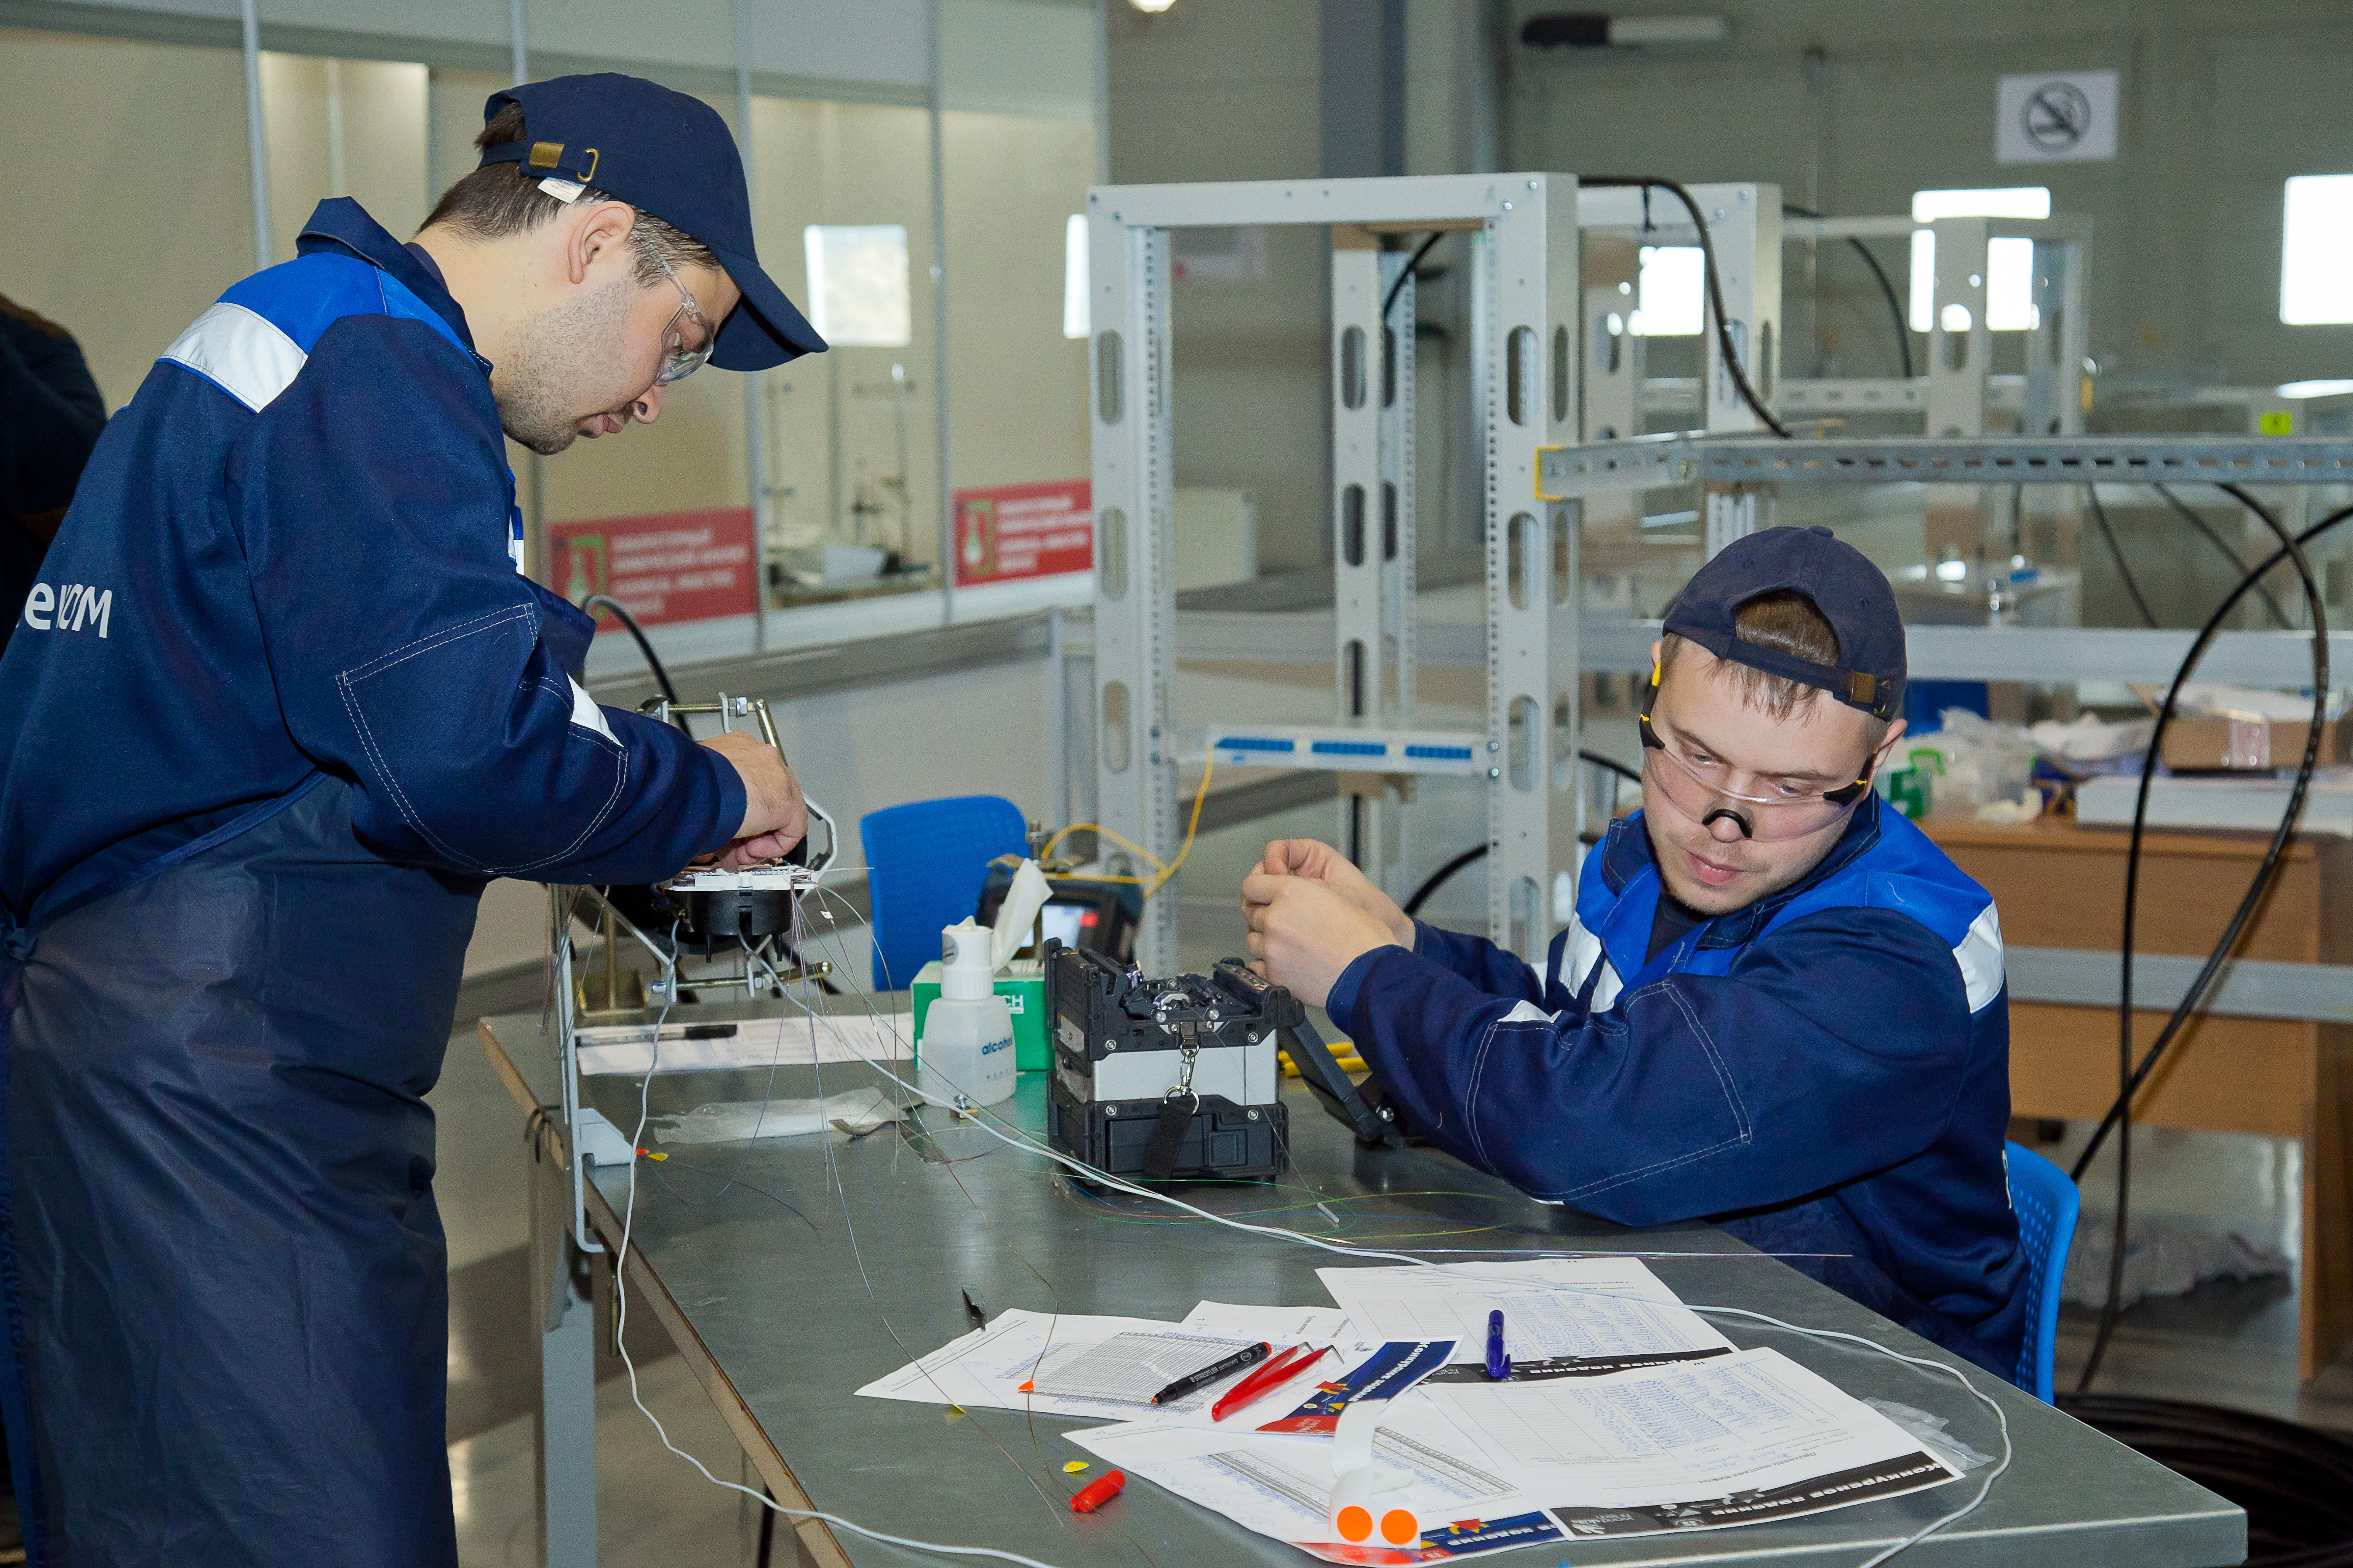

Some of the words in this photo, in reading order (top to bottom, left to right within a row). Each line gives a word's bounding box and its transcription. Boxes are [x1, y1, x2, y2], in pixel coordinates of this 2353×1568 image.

[1004, 995, 1024, 1007] CH
[1194, 1367, 1218, 1381] STAEDTLER
[1218, 1358, 1239, 1371] permanent
[1773, 1452, 1817, 1466] Протокол
[1733, 1464, 1772, 1478] монтажа
[1700, 1476, 1732, 1484] муфты
[1809, 1462, 1942, 1499] Конкурсное
[1710, 1495, 1806, 1515] задание
[1446, 1527, 1535, 1546] задание
